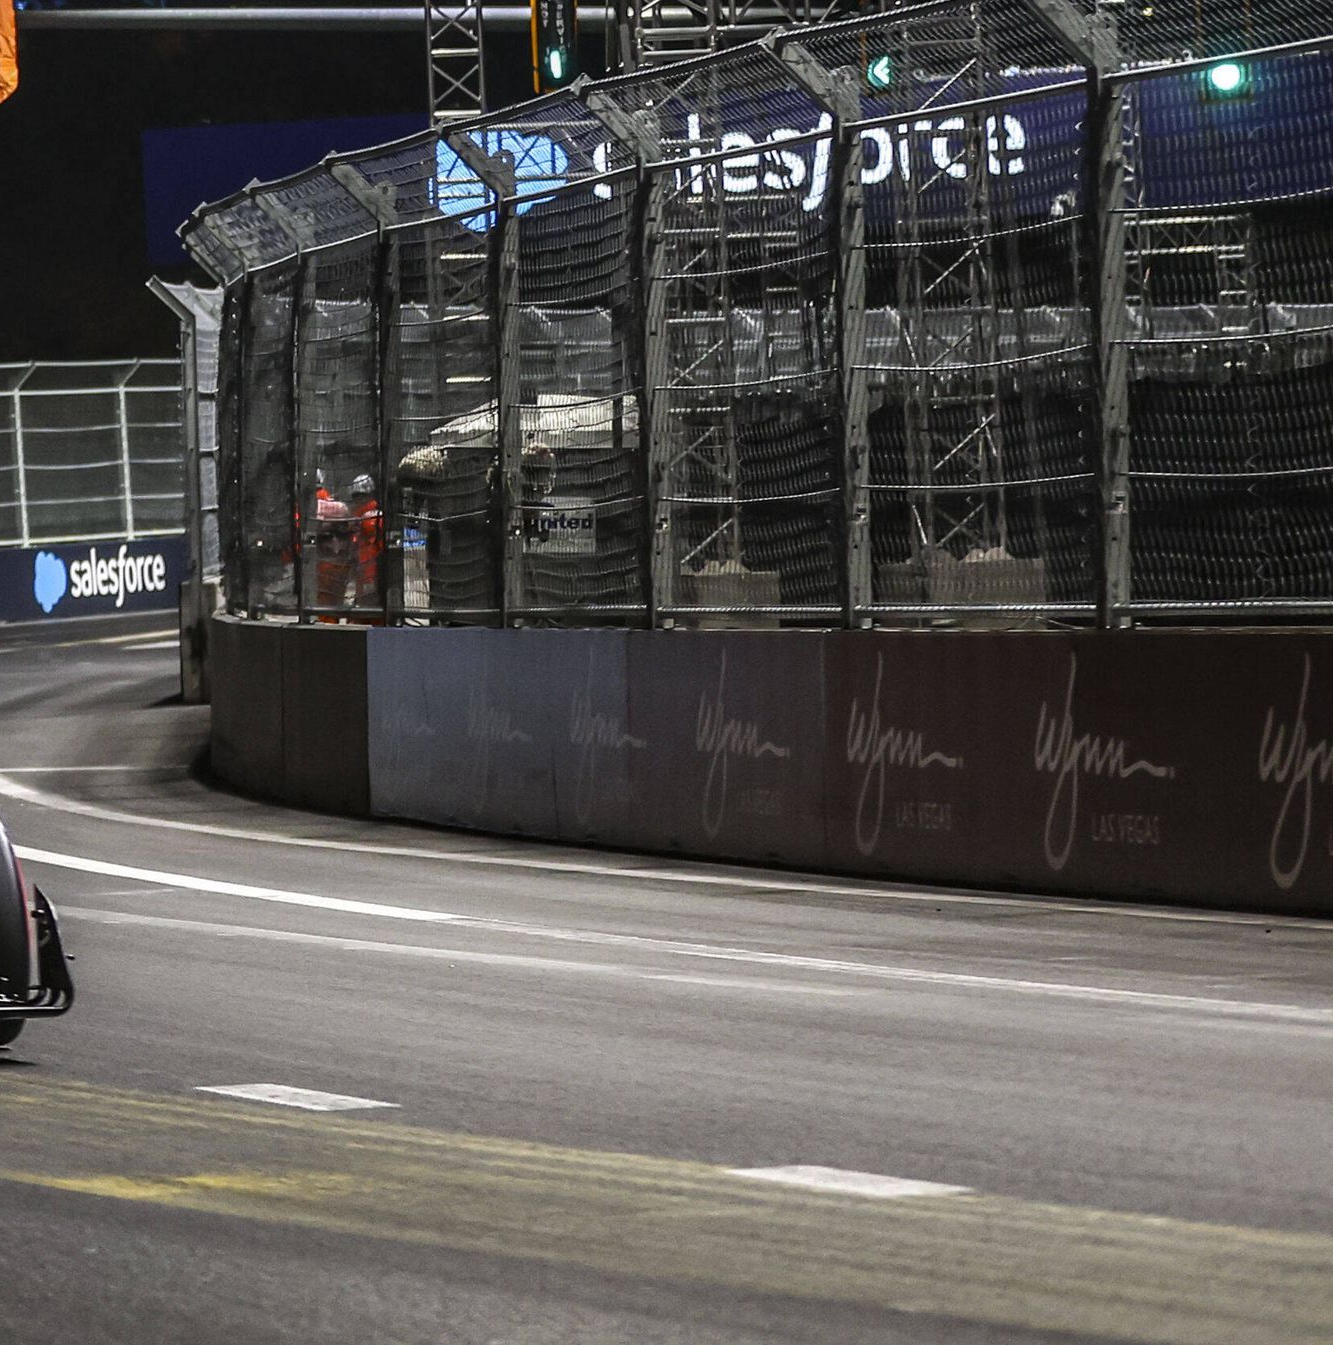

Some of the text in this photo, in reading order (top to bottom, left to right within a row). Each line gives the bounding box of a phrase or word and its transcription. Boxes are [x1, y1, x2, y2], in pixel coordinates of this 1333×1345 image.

[69, 544, 166, 608] salesforce
[846, 648, 957, 856] Wynn
[1033, 652, 1171, 872] Wynn
[1092, 814, 1116, 842] LAS
